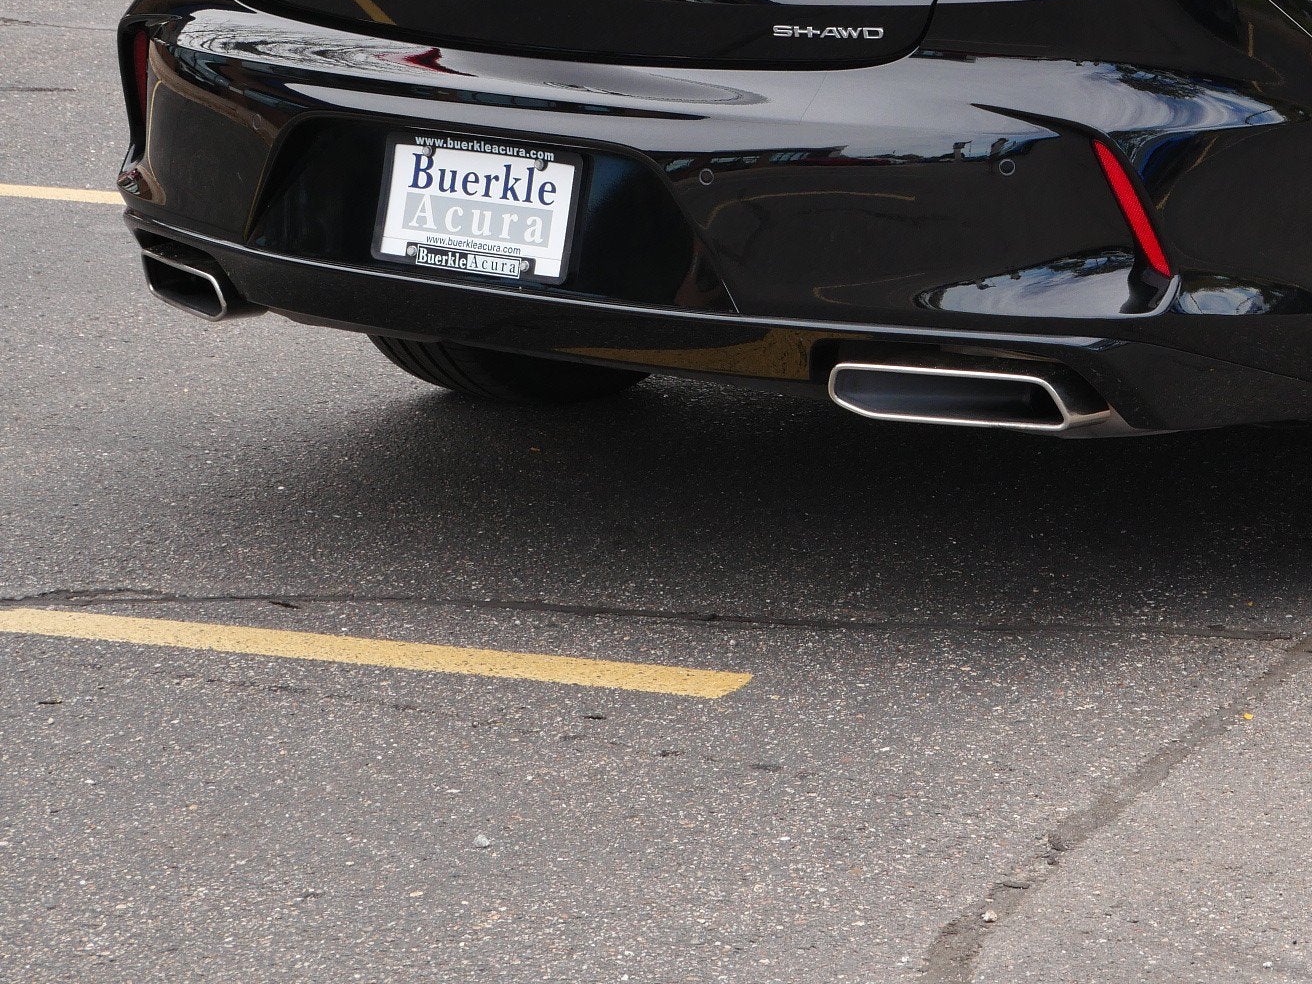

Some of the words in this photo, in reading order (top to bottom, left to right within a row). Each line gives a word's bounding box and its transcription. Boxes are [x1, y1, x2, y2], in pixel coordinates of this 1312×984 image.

[773, 25, 884, 39] SH-AWD
[415, 136, 555, 162] www.buerkleacura.com
[408, 152, 557, 205] Buerkle
[409, 194, 543, 244] Acura
[426, 235, 521, 255] www.buerkleacura.com
